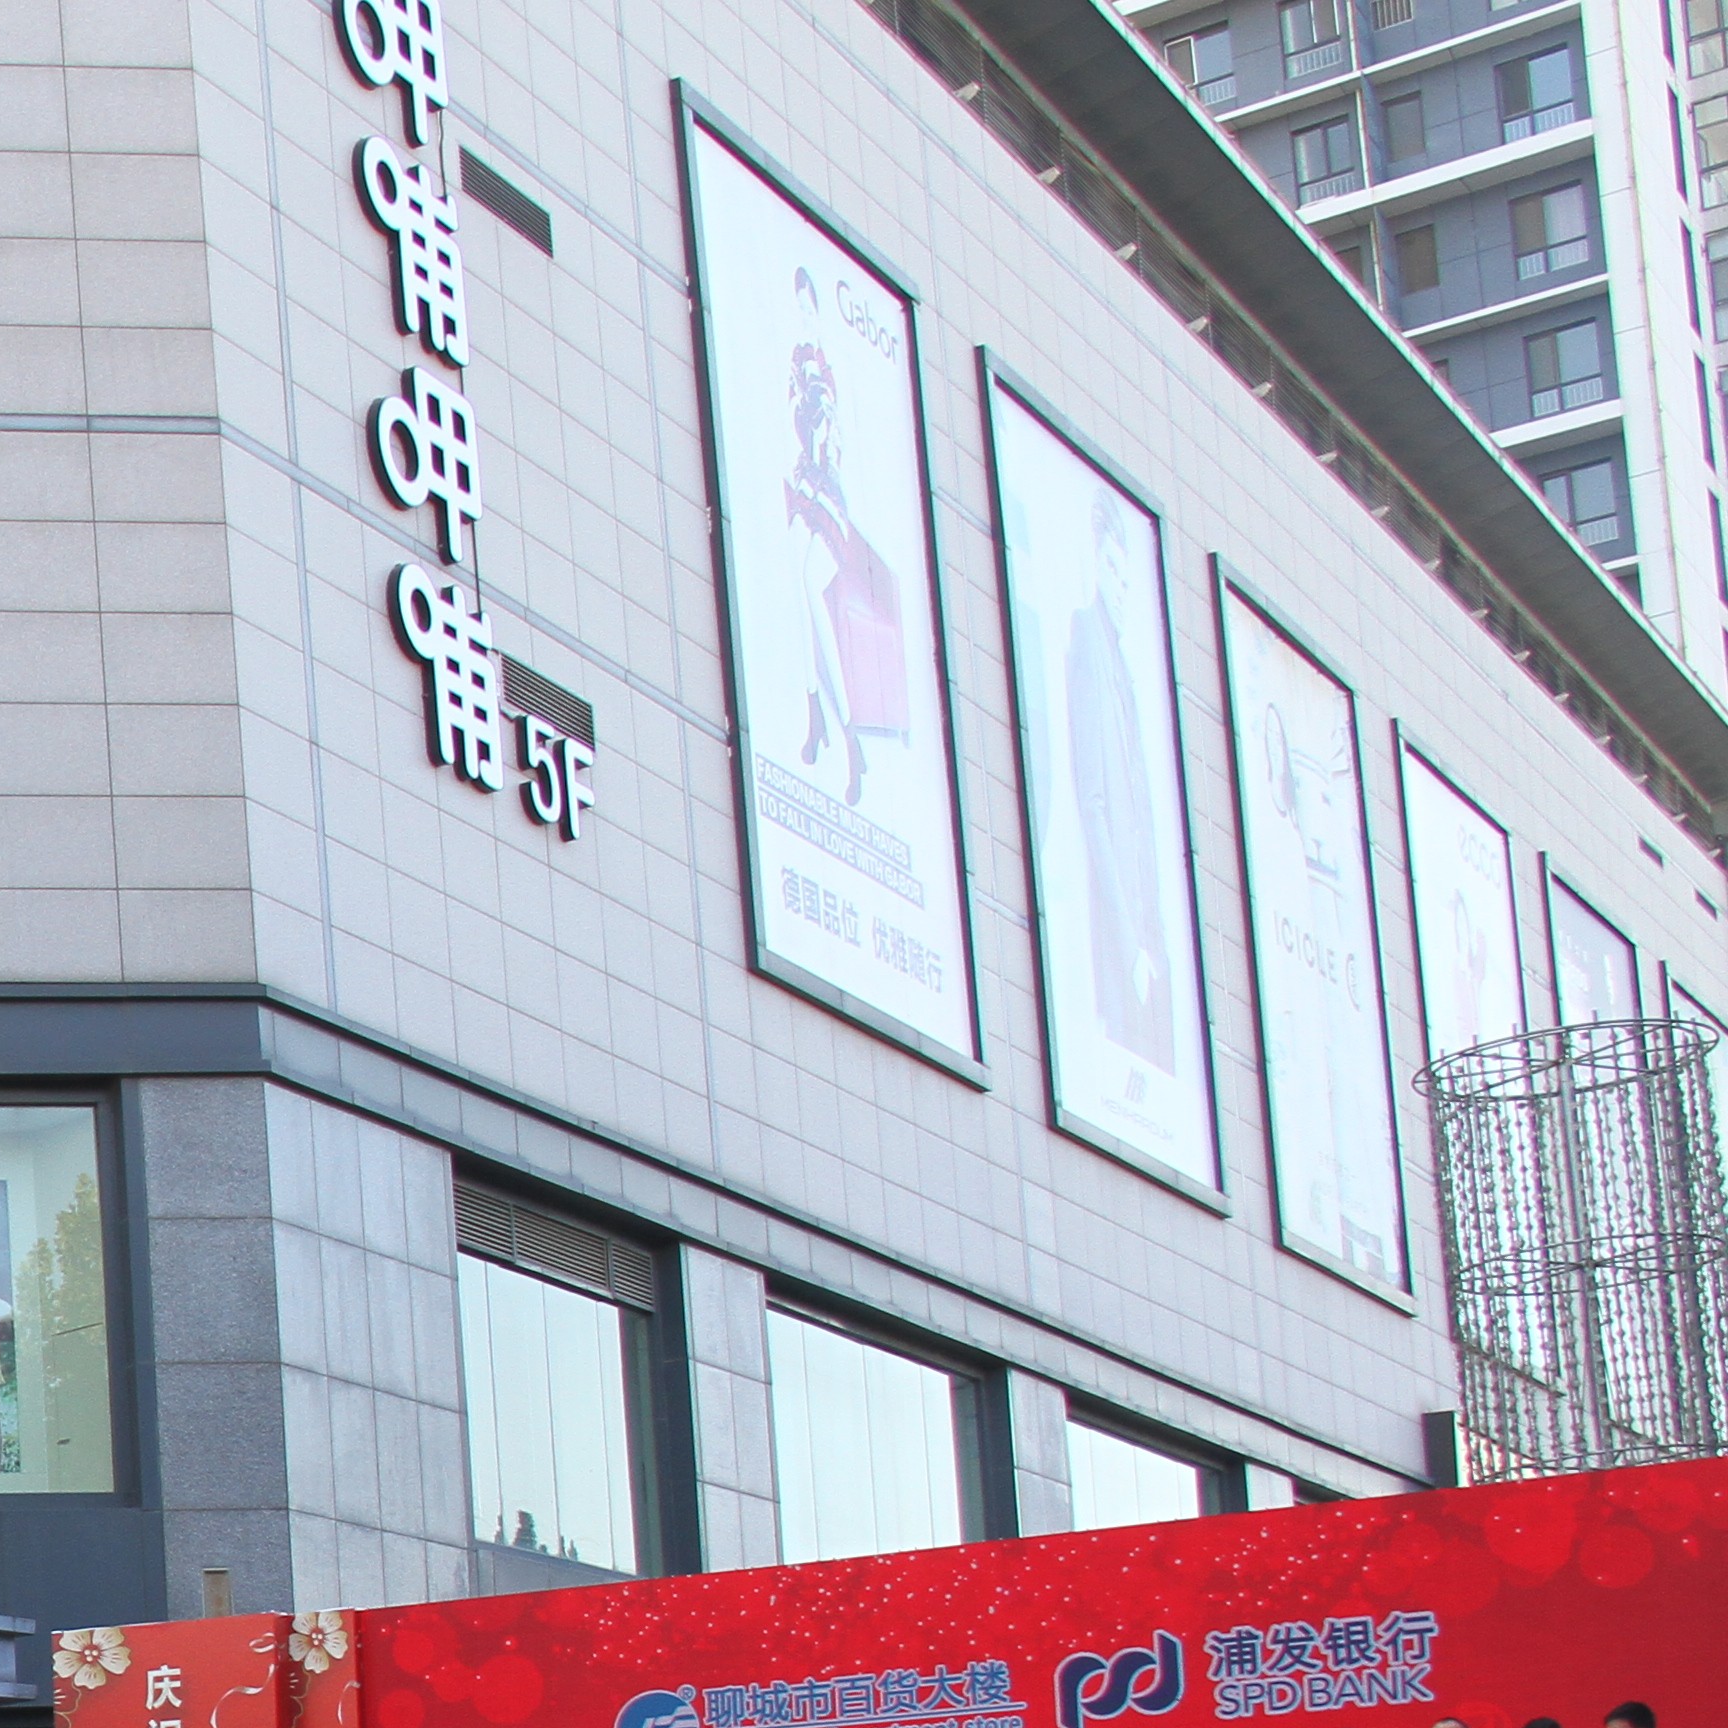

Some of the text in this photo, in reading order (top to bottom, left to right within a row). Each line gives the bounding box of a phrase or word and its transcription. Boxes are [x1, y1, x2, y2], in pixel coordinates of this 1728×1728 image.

[834, 278, 901, 366] Gabor
[516, 714, 595, 841] 5F
[755, 755, 840, 825] FASHIONABLE
[1273, 909, 1338, 986] ICICLE
[1204, 1609, 1439, 1681] 浦发银行
[1214, 1662, 1436, 1720] SPD BANK
